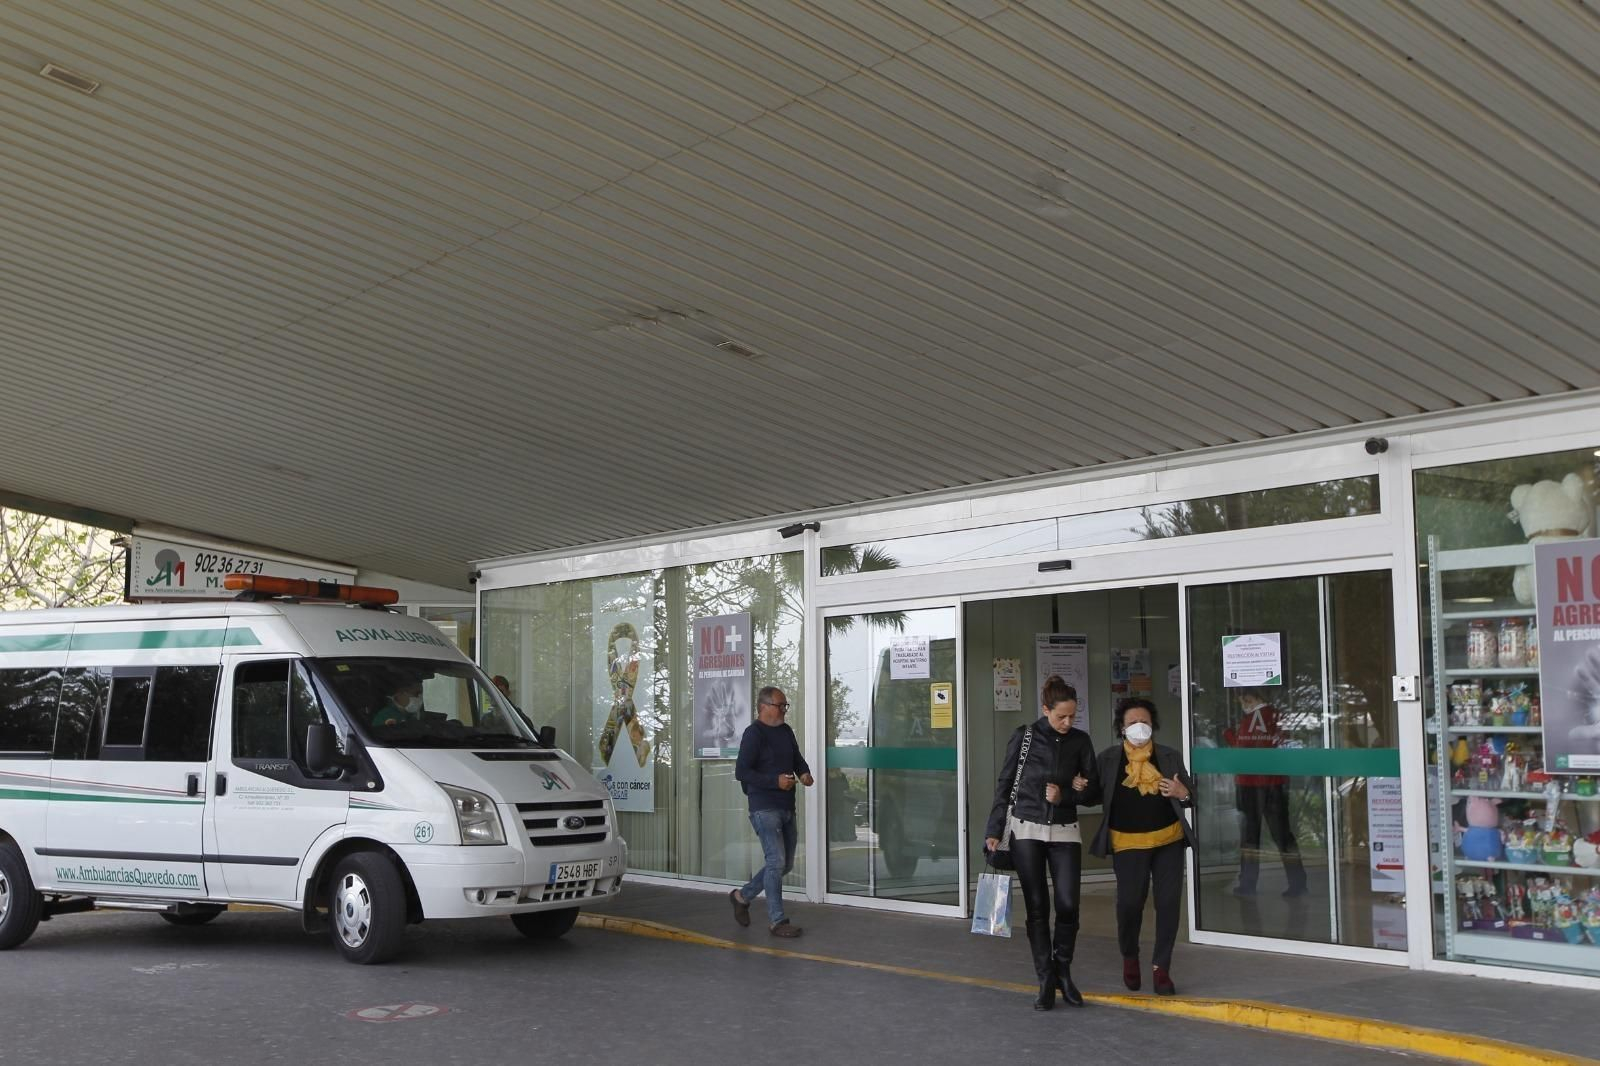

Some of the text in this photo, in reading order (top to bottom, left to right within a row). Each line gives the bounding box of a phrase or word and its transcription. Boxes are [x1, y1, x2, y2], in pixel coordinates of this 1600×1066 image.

[195, 553, 264, 574] 902 36 27 31
[1553, 629, 1565, 642] AL
[699, 654, 745, 669] AGRESIONES
[616, 781, 629, 790] con
[629, 779, 651, 790] cáncer
[416, 826, 431, 838] 261
[56, 865, 199, 887] www.AmbulanciasQuevedo.com
[557, 863, 599, 880] 2548 HBF
